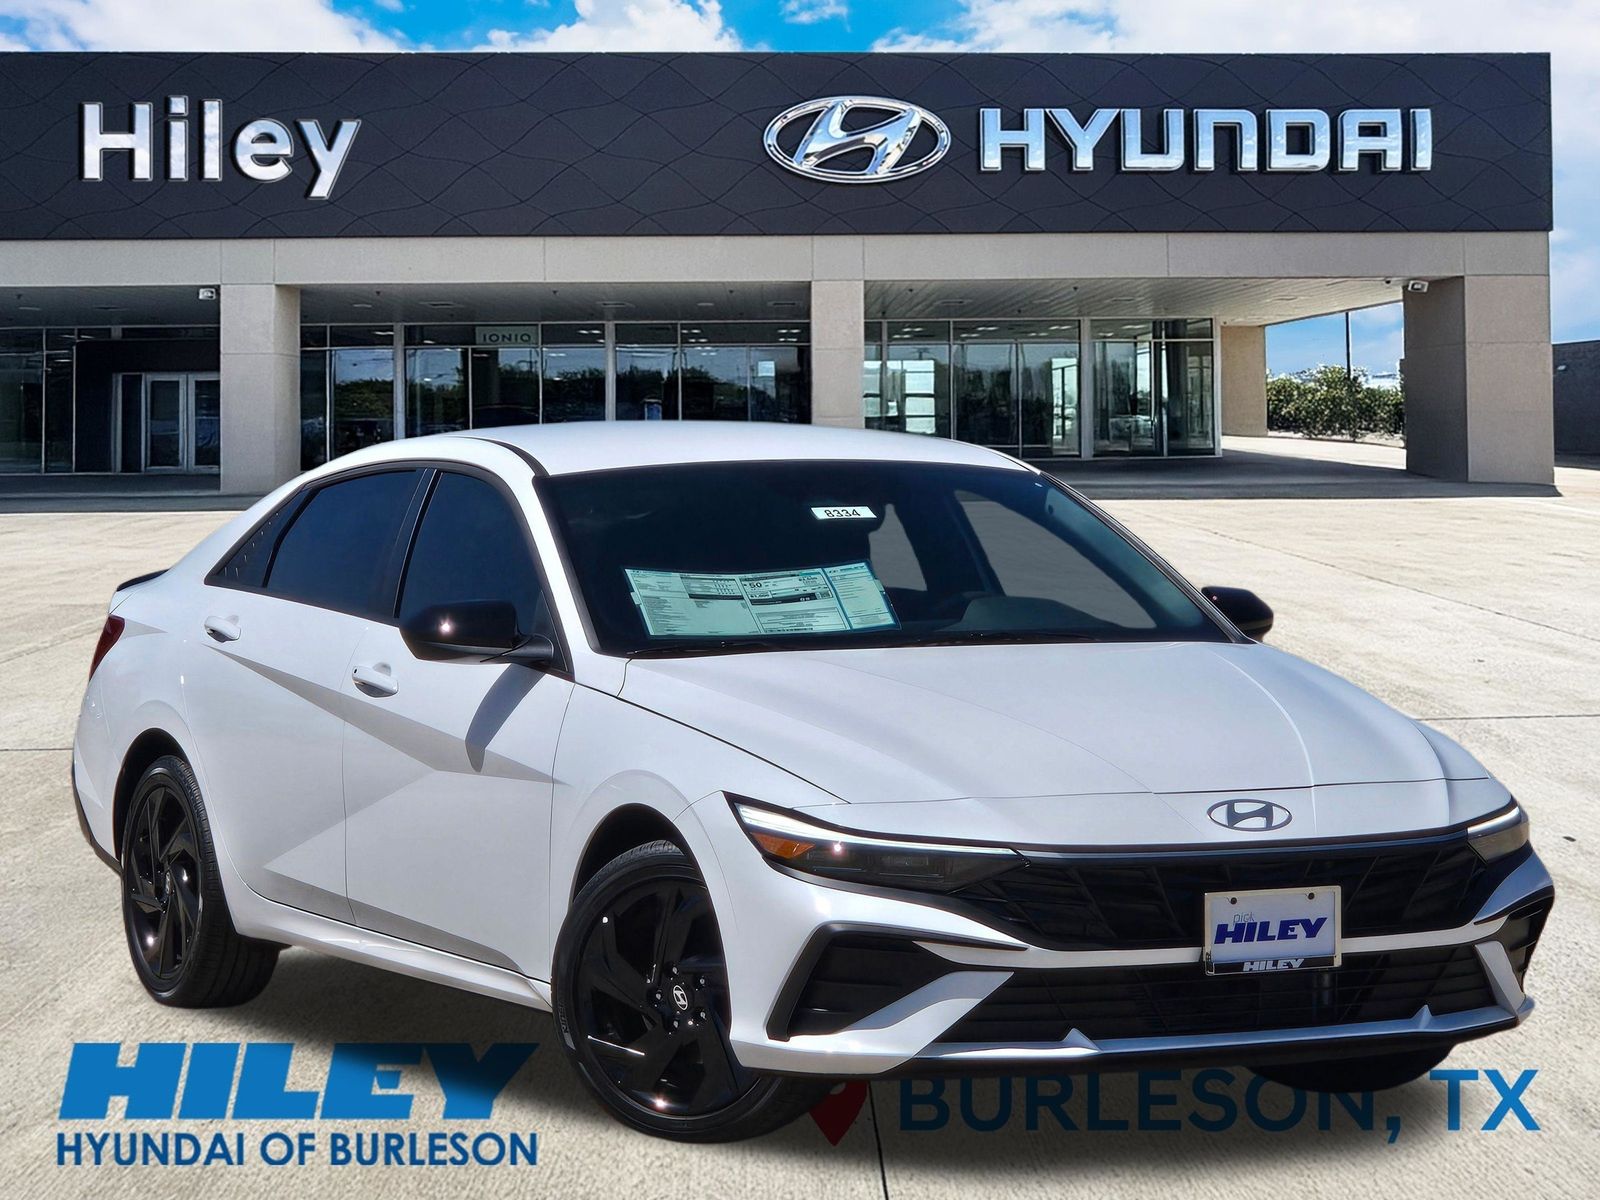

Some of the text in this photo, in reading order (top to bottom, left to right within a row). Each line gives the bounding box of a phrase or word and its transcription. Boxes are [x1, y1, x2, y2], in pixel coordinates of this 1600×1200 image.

[81, 95, 361, 200] Hiley
[979, 107, 1433, 172] HYUNDAI
[483, 332, 532, 343] IONIQ
[824, 508, 861, 518] 8334
[1214, 917, 1328, 945] HILEY
[1243, 958, 1305, 972] HILEY
